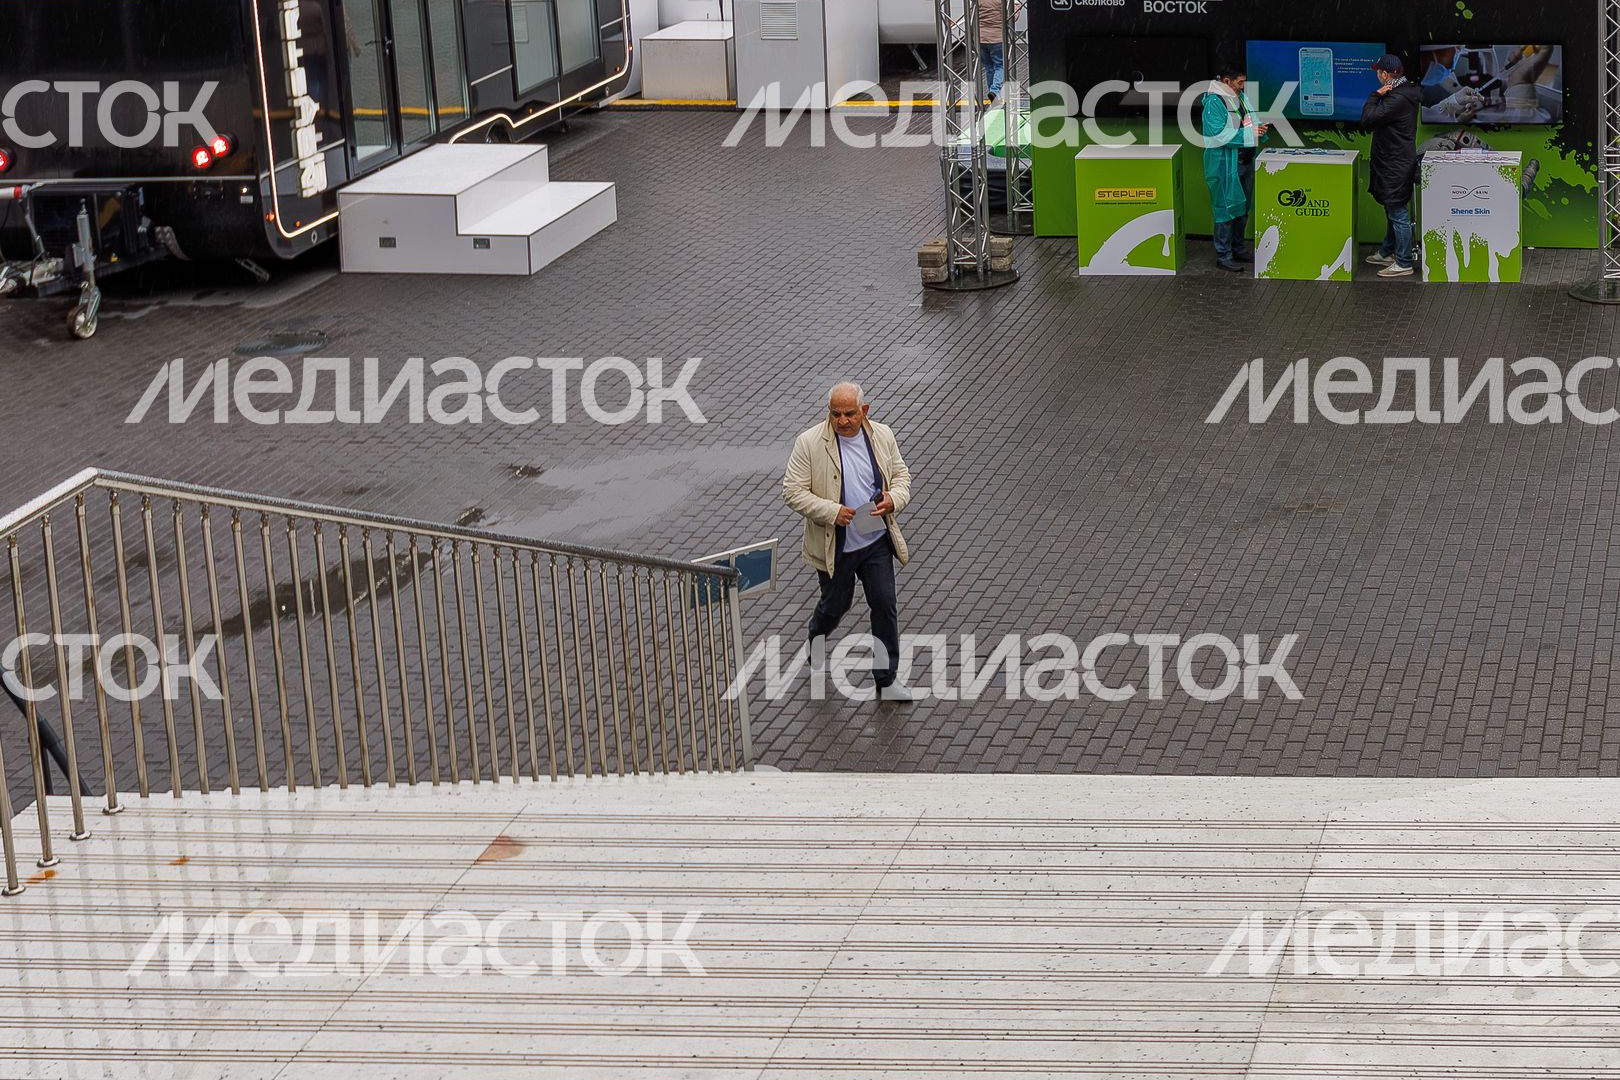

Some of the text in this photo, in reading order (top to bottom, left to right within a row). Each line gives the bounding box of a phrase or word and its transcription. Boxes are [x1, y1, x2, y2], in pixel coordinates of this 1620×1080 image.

[1144, 1, 1207, 14] ВОСТОК
[1097, 190, 1154, 198] STEPLIFE
[1295, 208, 1330, 217] GUIDE
[1451, 207, 1490, 215] Shene Skin
